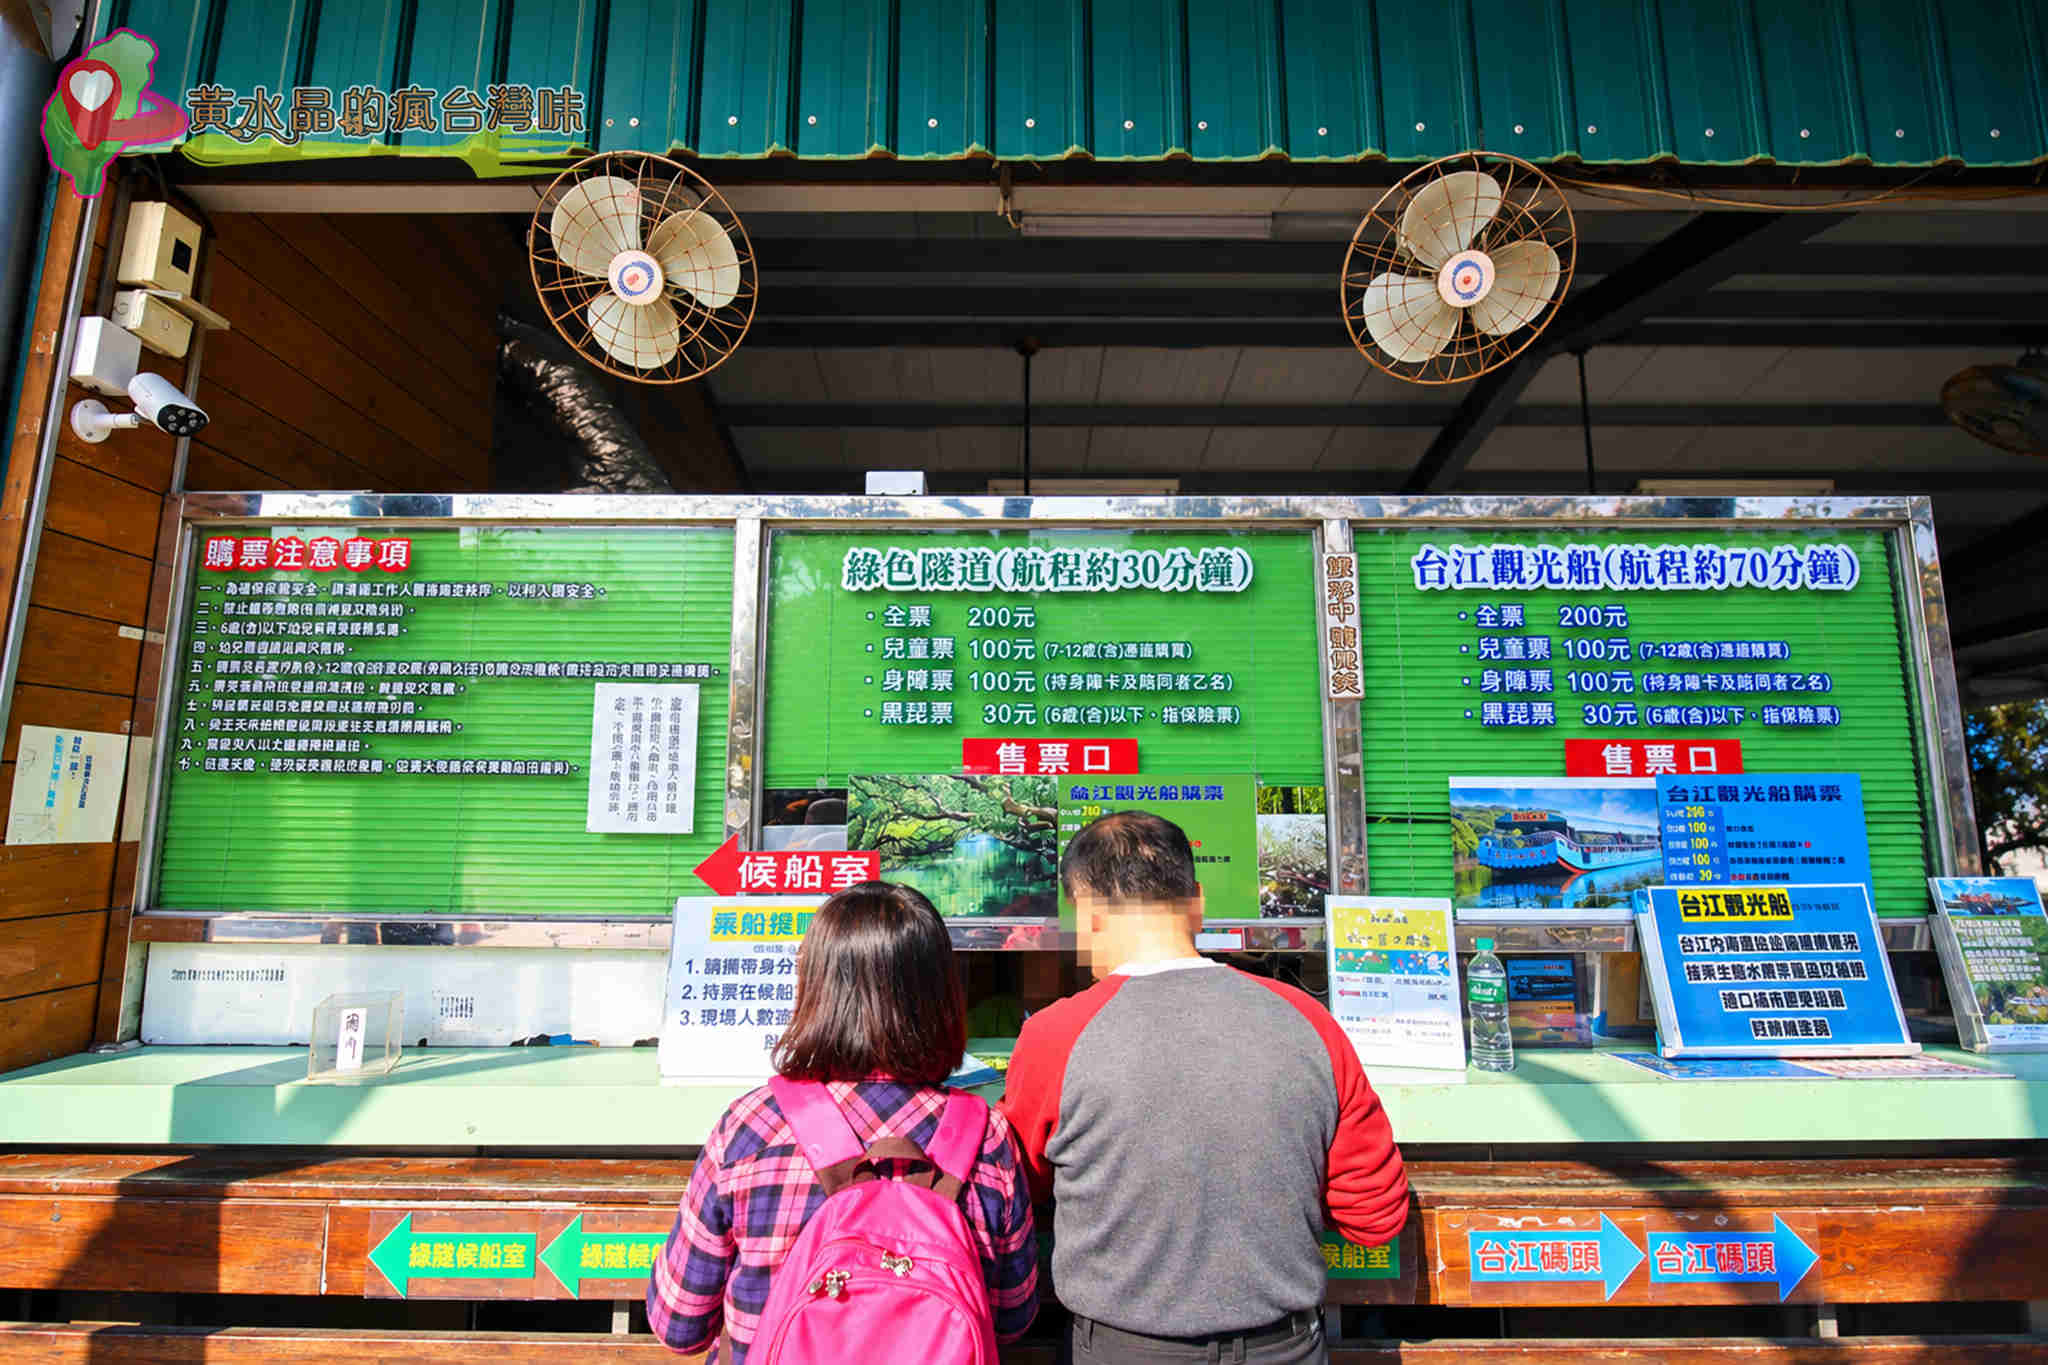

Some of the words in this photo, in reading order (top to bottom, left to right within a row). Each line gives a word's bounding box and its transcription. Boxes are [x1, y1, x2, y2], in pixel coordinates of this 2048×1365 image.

[205, 538, 411, 568] 購票注意事項
[845, 549, 1253, 589] 綠色隧道(航程約30分鐘)
[1415, 547, 1858, 588] 台江觀光船(航程約70分鐘)
[883, 606, 932, 628] 全票
[968, 606, 1036, 628] 200元
[1476, 606, 1524, 628] 全票
[1559, 606, 1629, 628] 200元
[882, 637, 954, 660] 兒童票
[968, 638, 1036, 660] 100元
[1477, 637, 1552, 660] 兒童票
[1564, 638, 1631, 661] 100元
[881, 670, 954, 692] 身障票
[968, 670, 1036, 693] 100元
[1481, 670, 1553, 693] 身障票
[1567, 671, 1634, 693] 100元
[881, 702, 954, 724] 黑琵票
[983, 703, 1037, 725] 30元
[1482, 702, 1555, 725] 黑琵票
[1584, 703, 1638, 725] 30元
[996, 742, 1111, 774] 售票口
[1602, 744, 1718, 776] 售票口
[1667, 785, 1843, 802] 台江觀光船購票
[738, 854, 870, 888] 候船室
[1681, 893, 1791, 917] 台江觀光船
[704, 957, 799, 976] 請攜帶身分
[702, 983, 799, 1001] 持票在候船
[409, 1242, 527, 1268] 綠隧候船室
[1477, 1241, 1601, 1275] 台江碼頭
[1656, 1241, 1775, 1275] 台江碼頭
